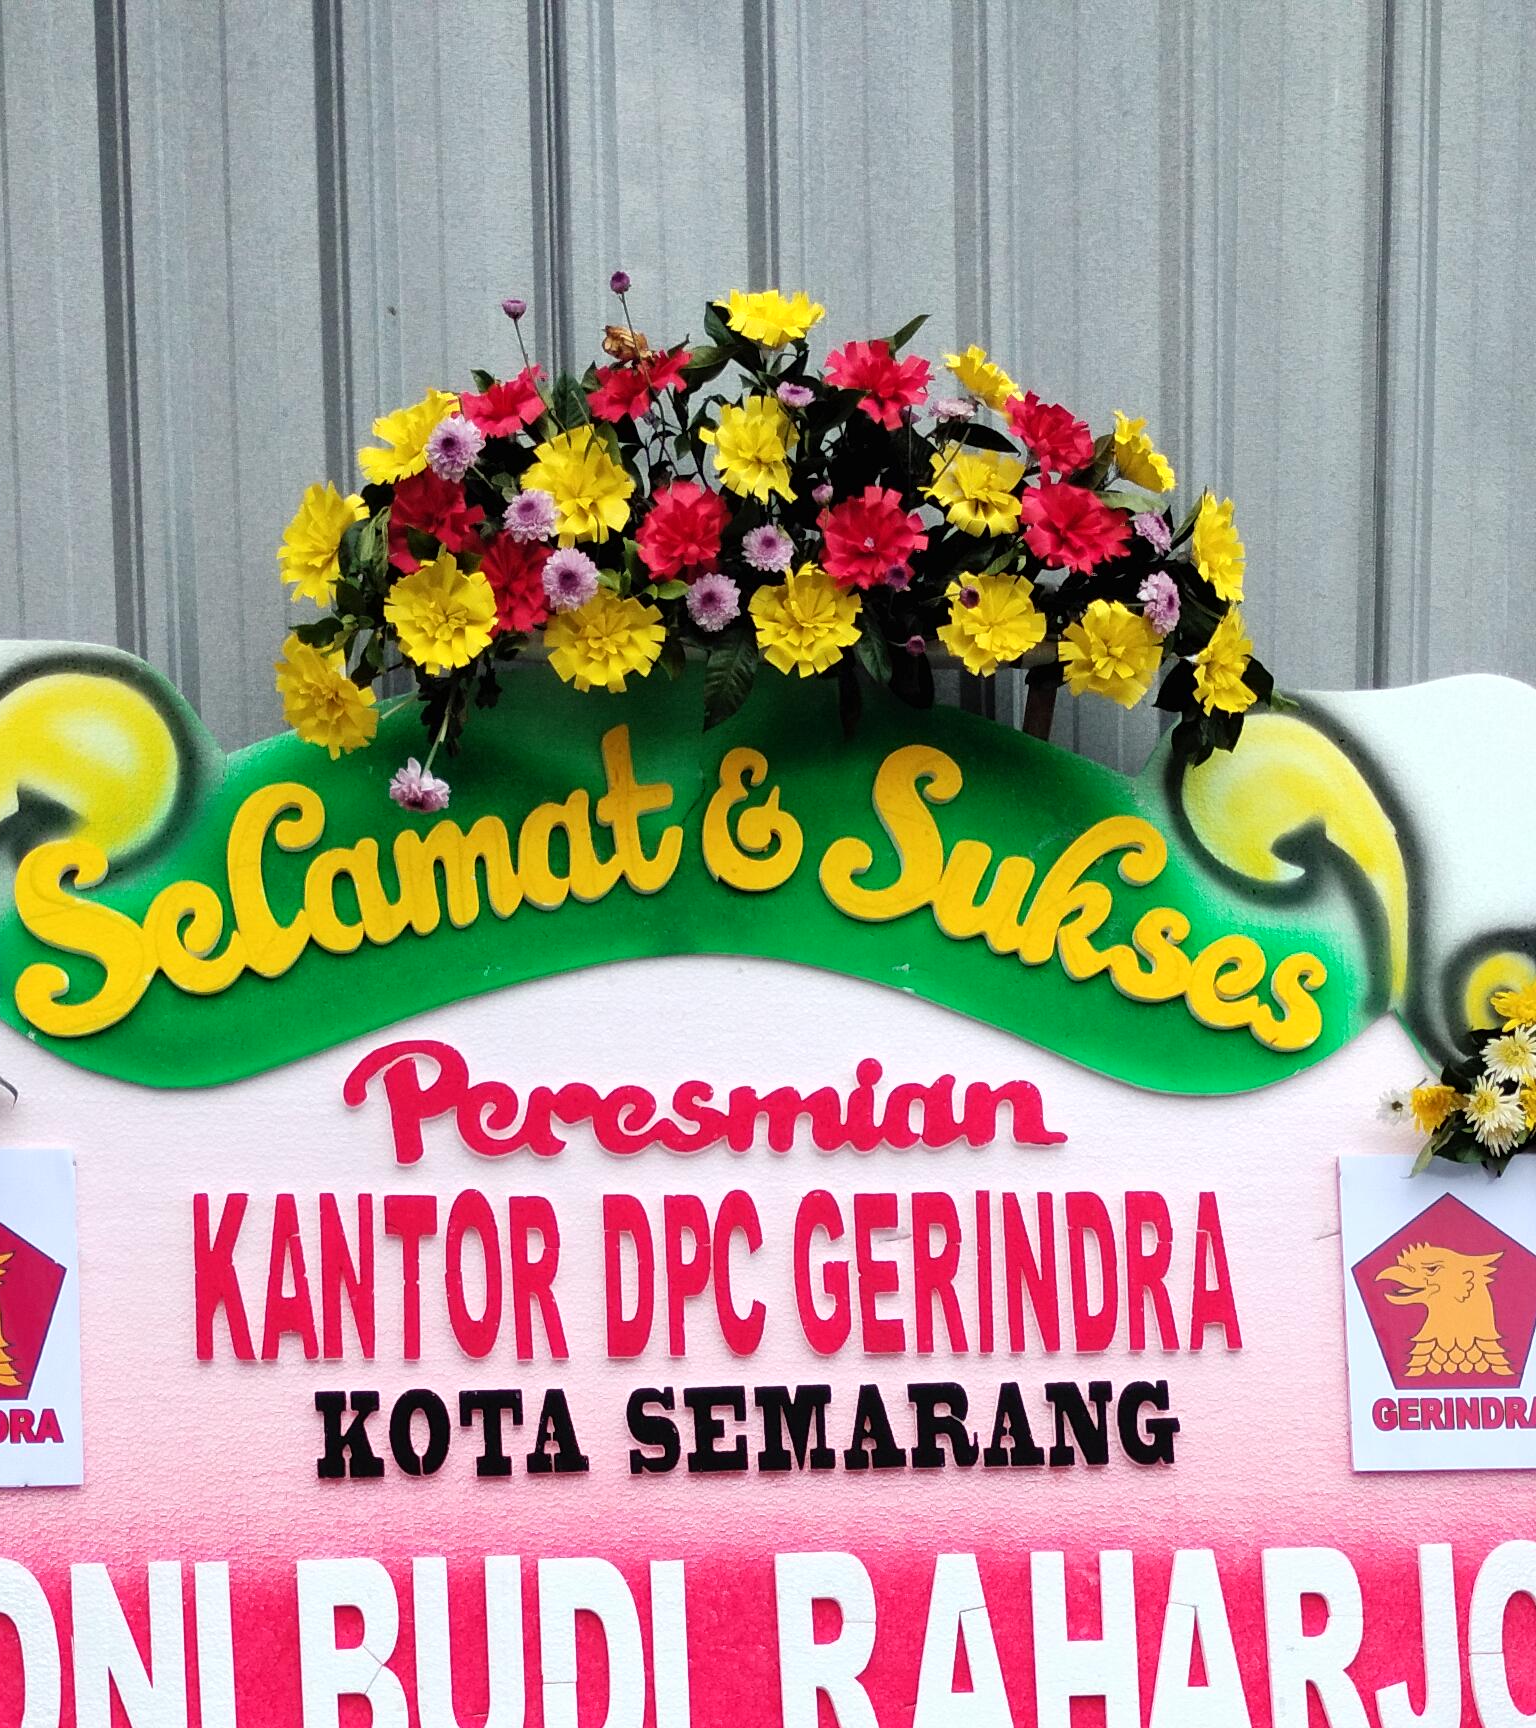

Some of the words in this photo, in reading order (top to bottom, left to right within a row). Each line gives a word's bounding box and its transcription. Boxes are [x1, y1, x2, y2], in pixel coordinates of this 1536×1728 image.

[13, 724, 683, 1037] Selamat
[703, 748, 804, 892] &
[820, 744, 1326, 1052] Sukses
[344, 1040, 1068, 1166] Peresmian
[193, 1189, 569, 1361] KANTOR
[602, 1190, 767, 1358] DPC
[793, 1189, 1243, 1355] GERINDRA
[314, 1389, 590, 1479] KOTA
[626, 1380, 1181, 1475] SEMARANG
